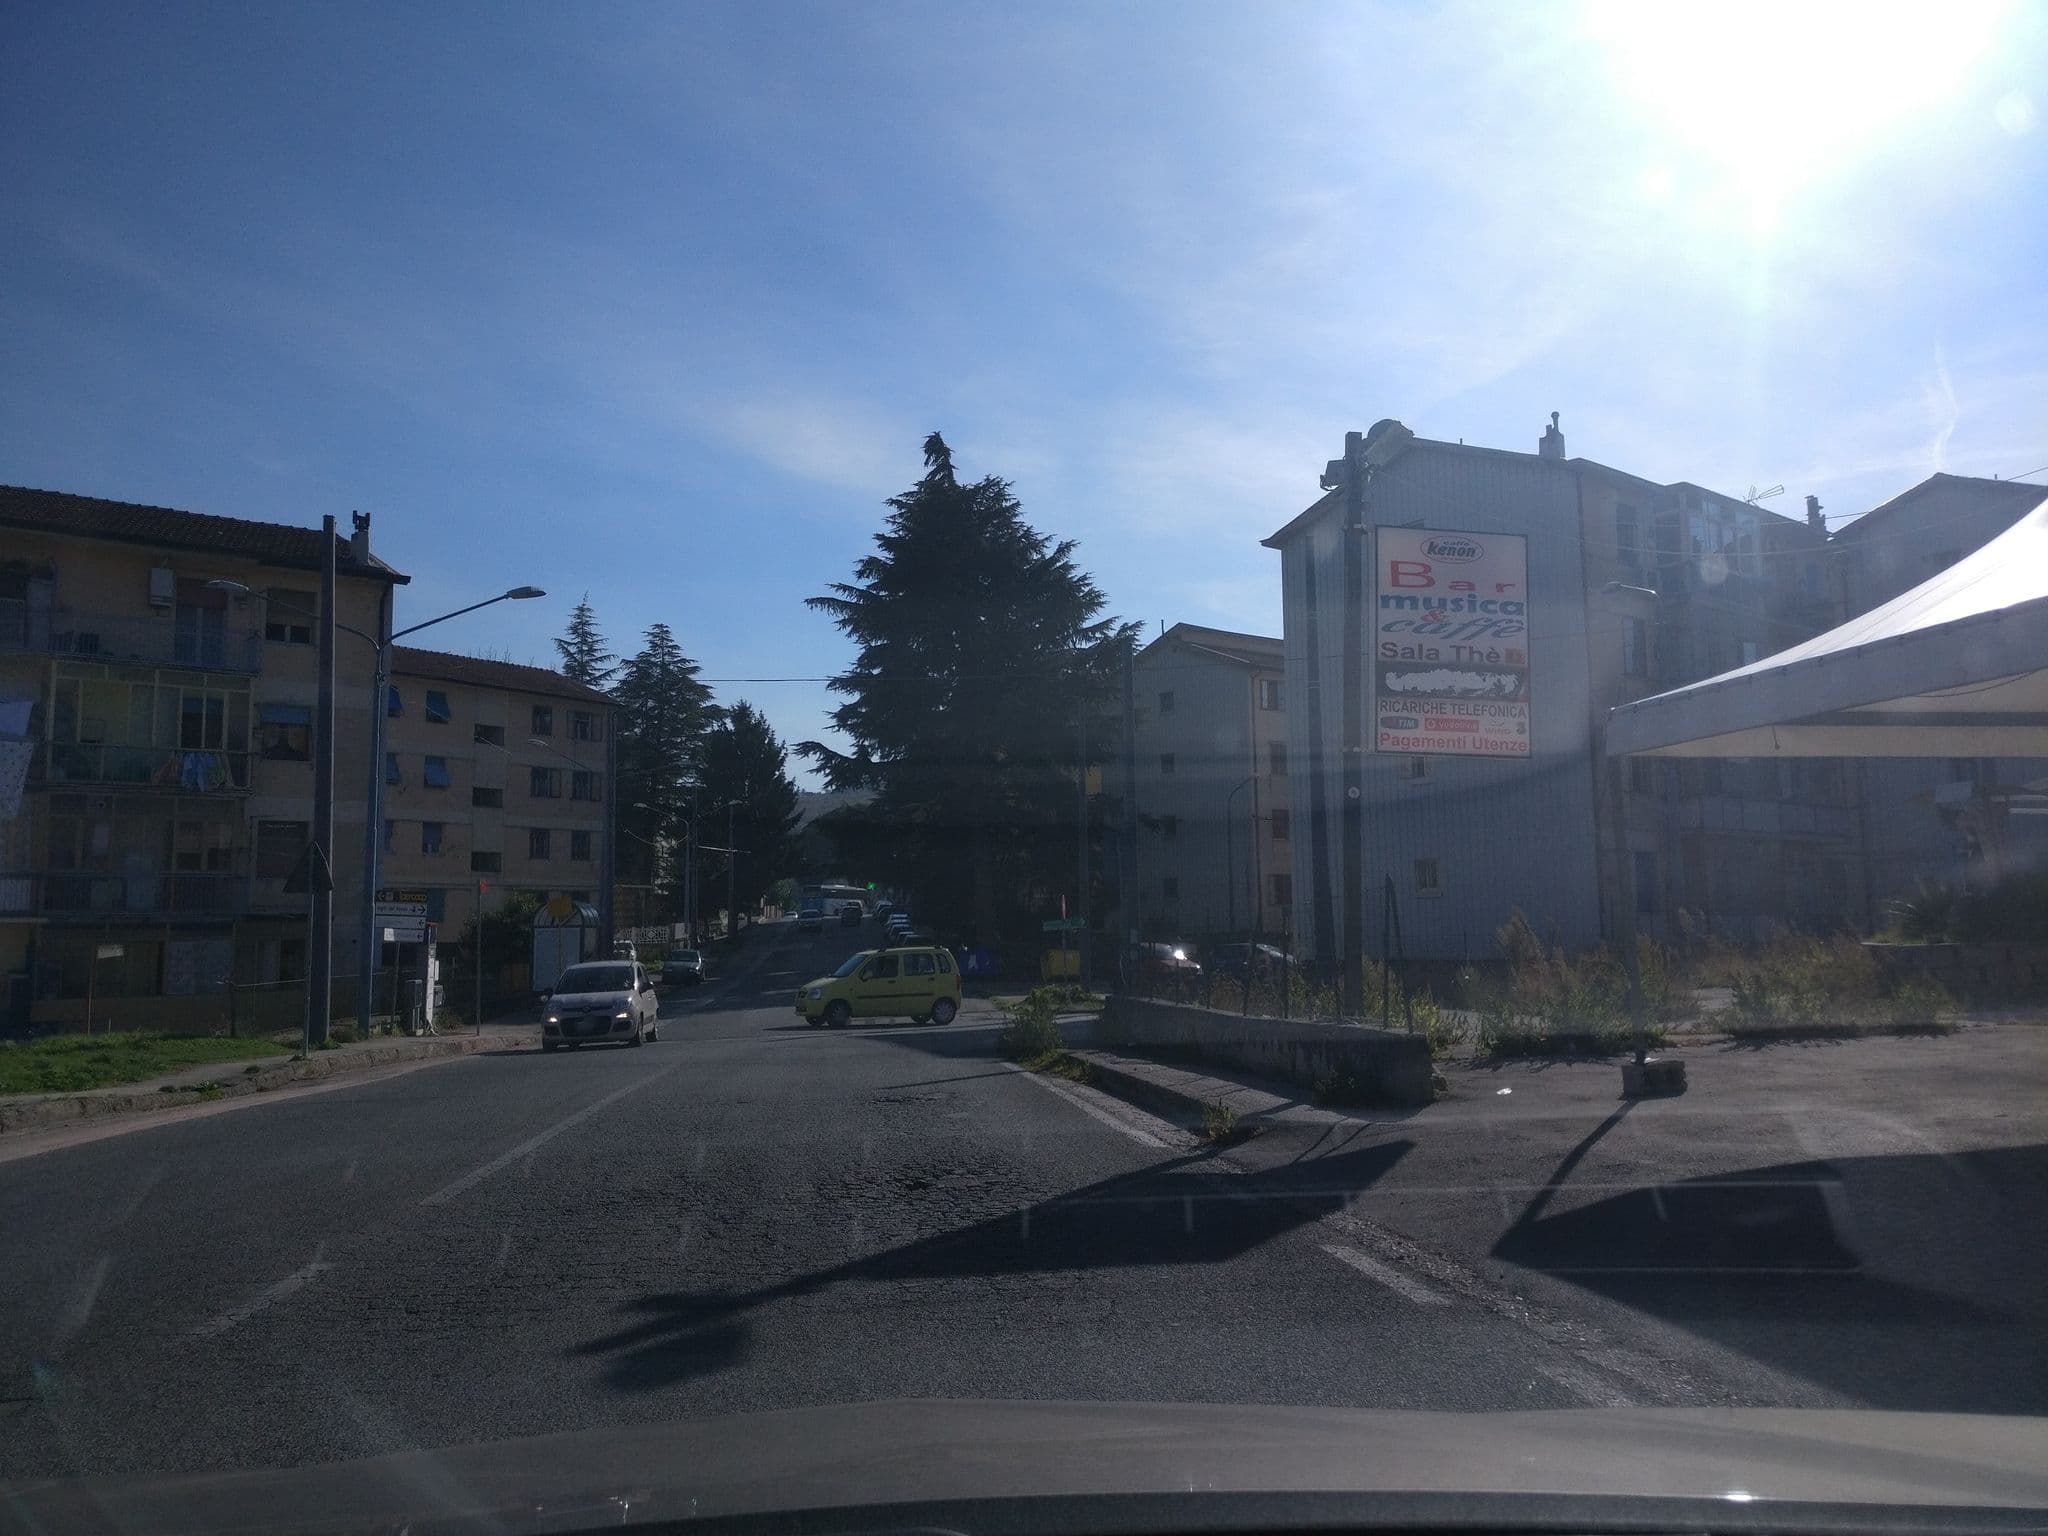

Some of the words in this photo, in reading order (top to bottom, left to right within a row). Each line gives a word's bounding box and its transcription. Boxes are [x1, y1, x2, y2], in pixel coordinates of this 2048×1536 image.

[1391, 560, 1516, 593] Bar
[1380, 593, 1525, 616] musica
[1420, 607, 1449, 623] &
[1381, 616, 1526, 641] caffè
[1380, 641, 1440, 661] Sala
[1449, 644, 1501, 663] Thè
[1380, 699, 1447, 716] RICARICHE
[1449, 703, 1526, 719] TELEFONICA
[1398, 719, 1415, 728] TIM
[1379, 731, 1466, 750] Pagamenti
[1472, 737, 1528, 753] Utenze
